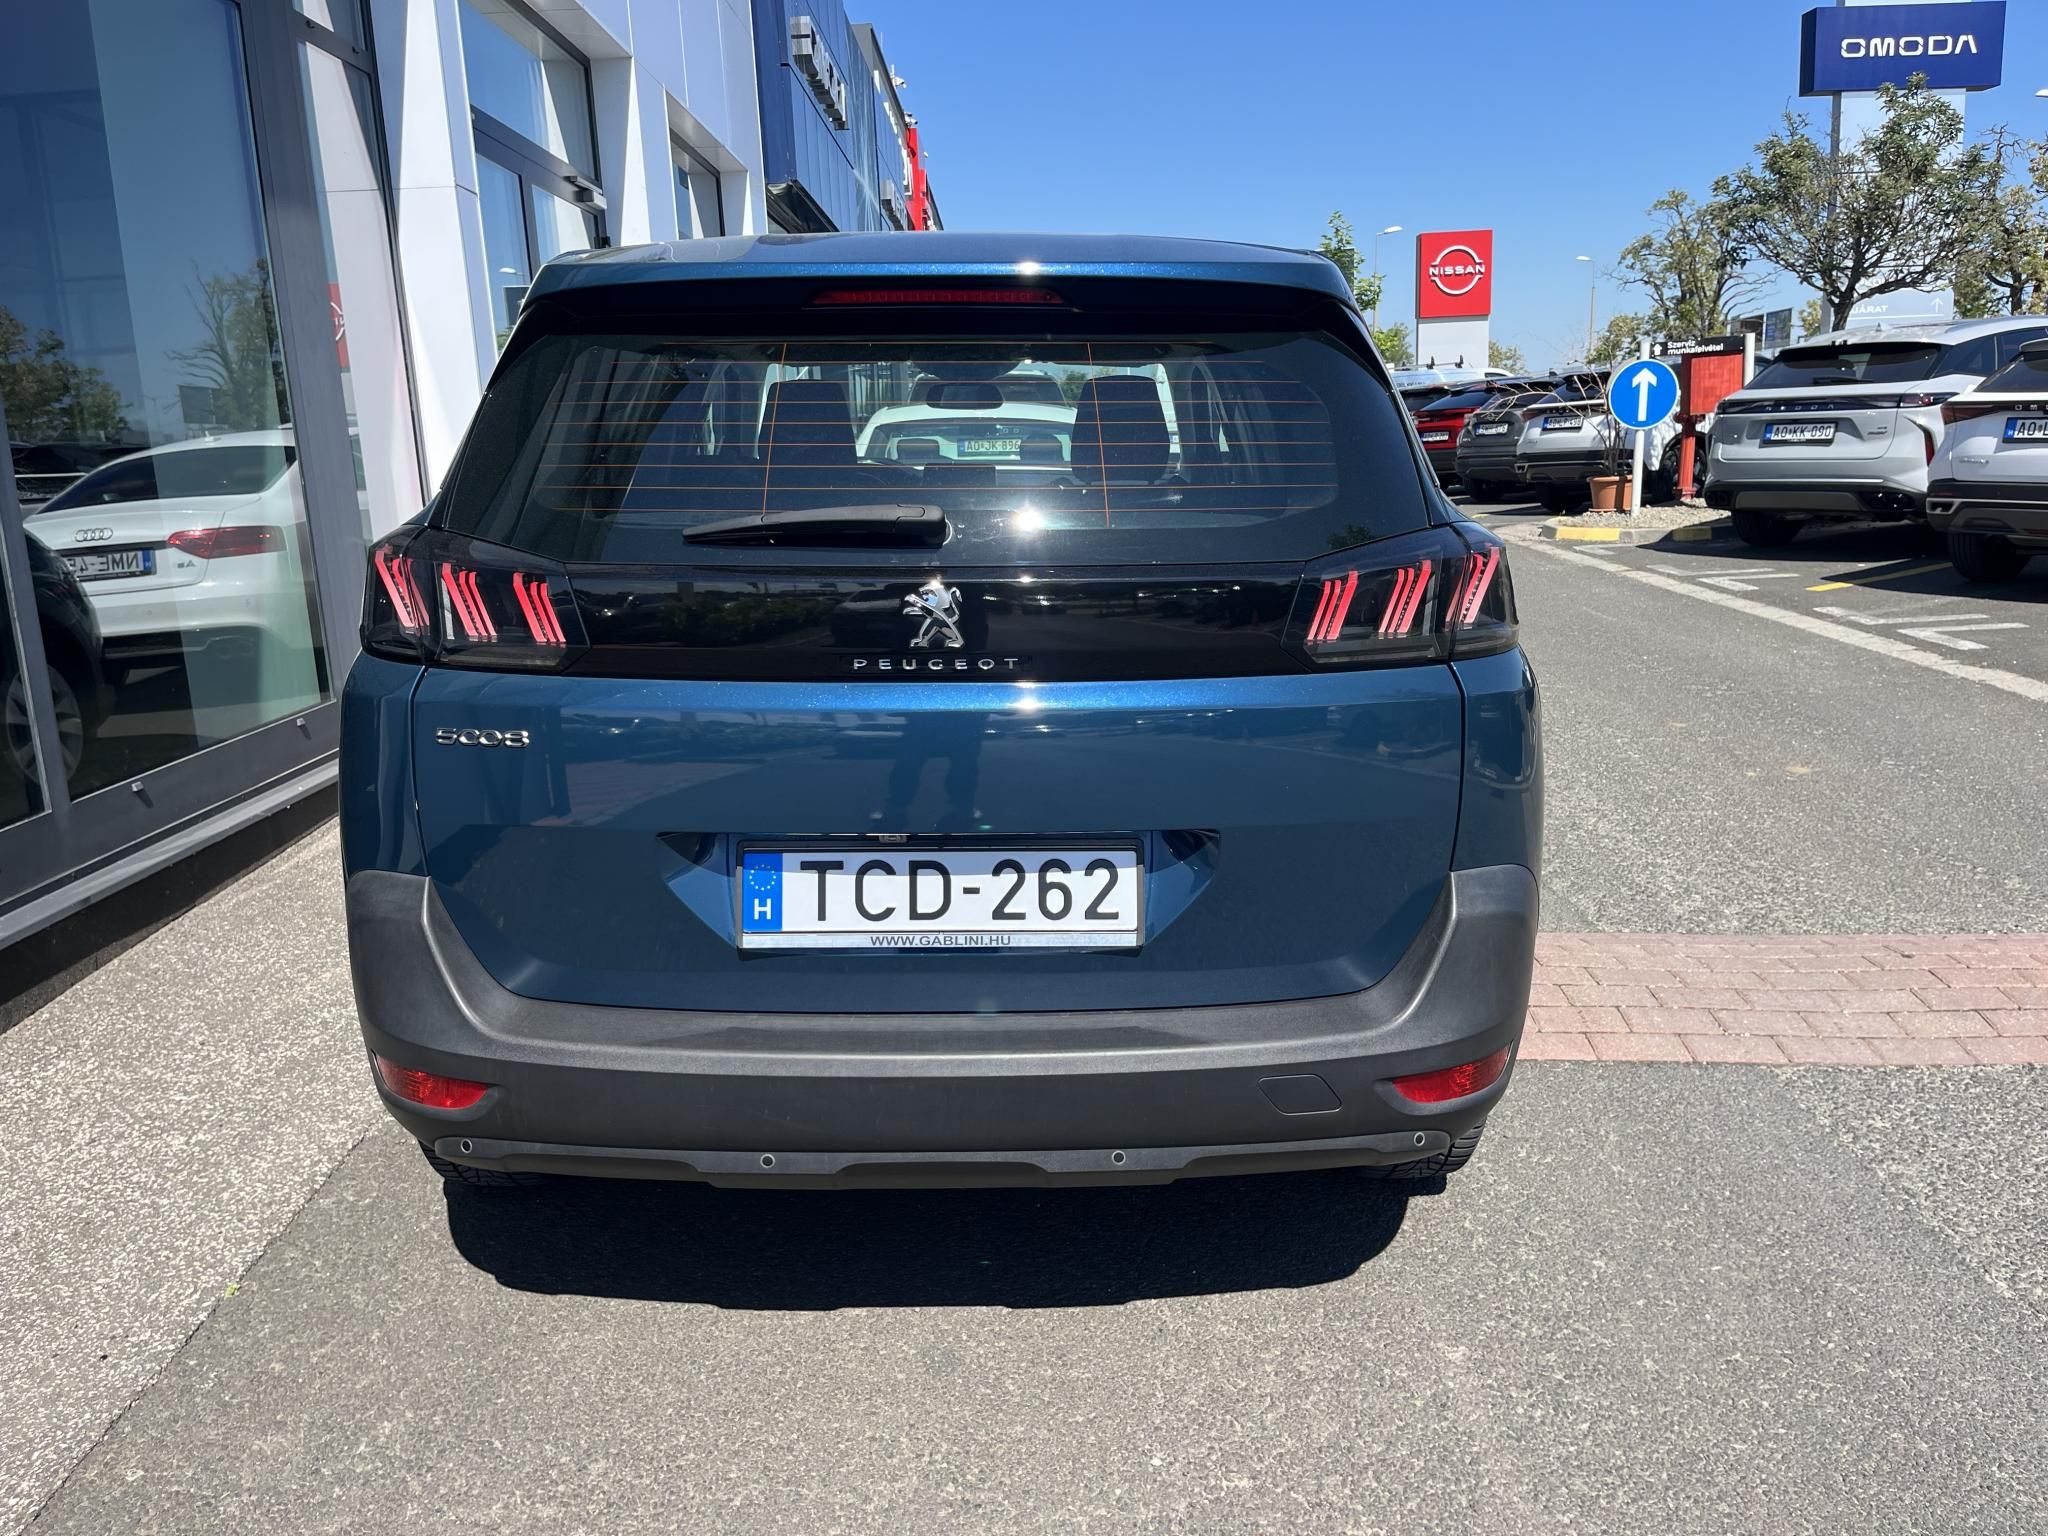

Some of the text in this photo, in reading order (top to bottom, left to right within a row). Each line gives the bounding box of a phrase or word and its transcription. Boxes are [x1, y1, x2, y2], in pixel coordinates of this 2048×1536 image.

[1840, 35, 1978, 58] OMODA
[1429, 264, 1486, 276] NISSAN
[1667, 340, 1696, 349] Szerviz
[853, 658, 1019, 670] PEUGEOT
[436, 727, 530, 748] 5008
[753, 858, 1120, 922] H TCD-262
[870, 935, 1011, 947] WWW.GABLINI.HU
